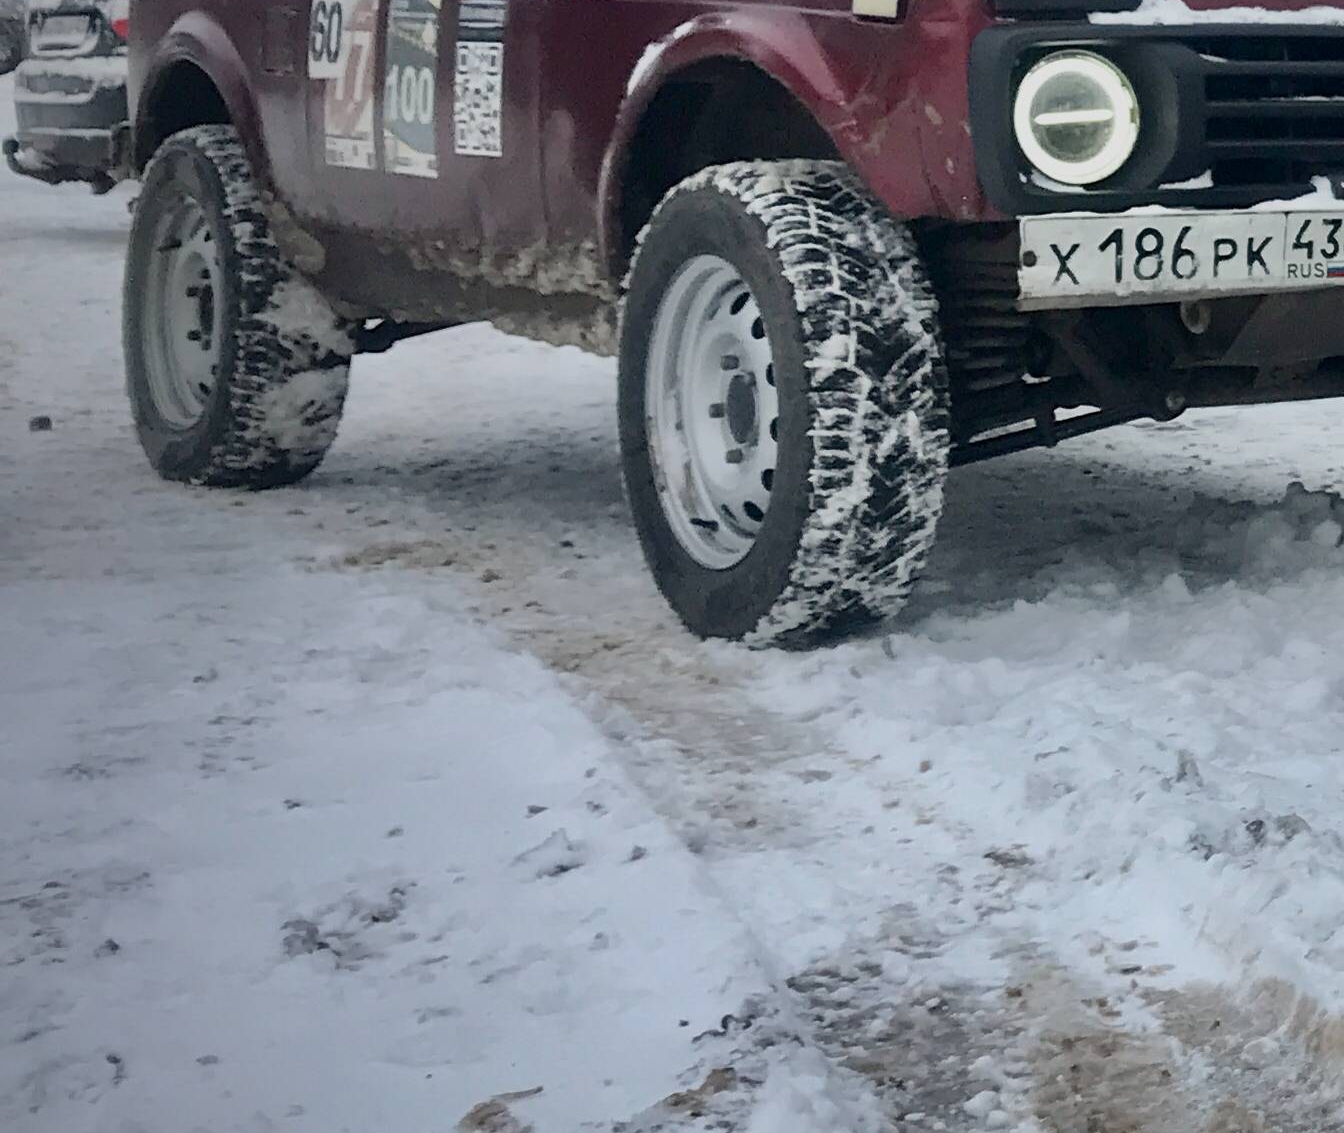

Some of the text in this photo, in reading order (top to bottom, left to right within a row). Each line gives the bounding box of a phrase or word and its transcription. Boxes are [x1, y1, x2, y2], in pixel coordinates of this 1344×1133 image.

[385, 64, 435, 124] 100
[1292, 219, 1343, 259] 43
[1287, 264, 1325, 279] RUS
